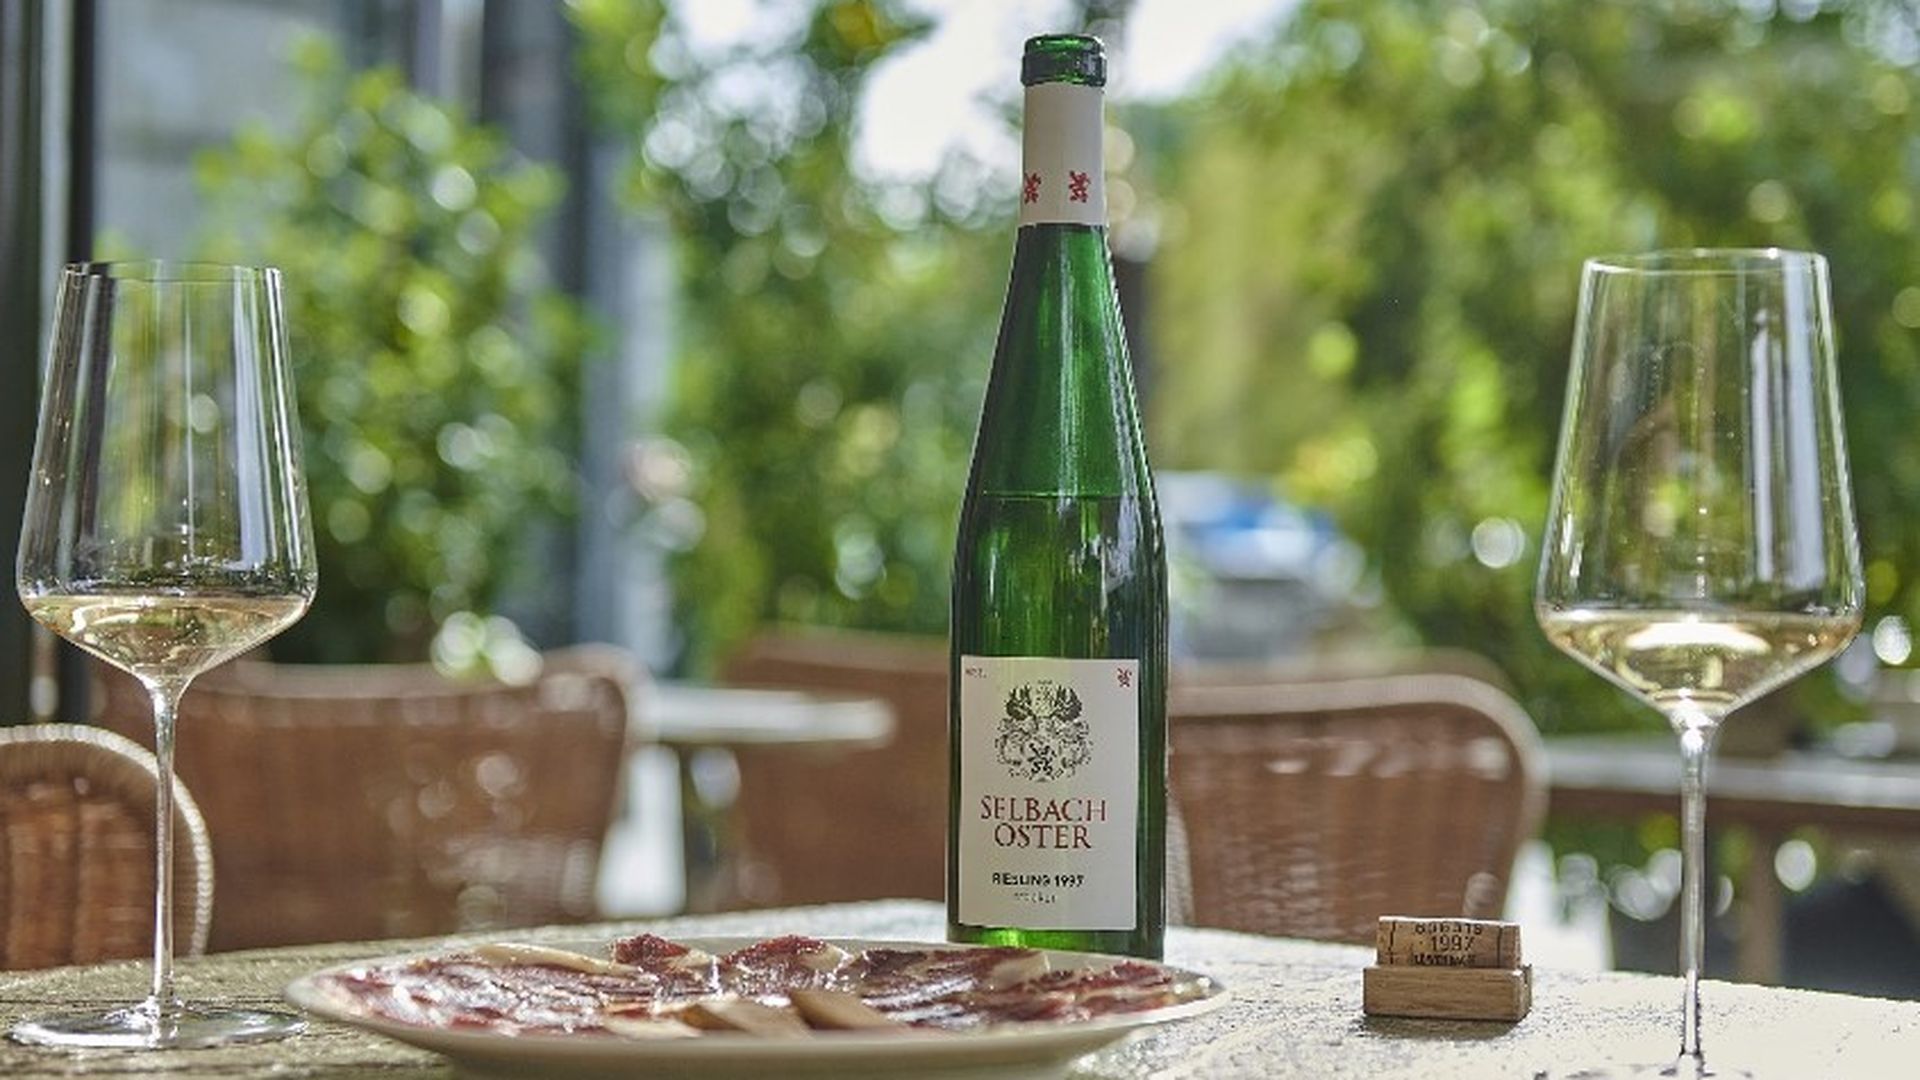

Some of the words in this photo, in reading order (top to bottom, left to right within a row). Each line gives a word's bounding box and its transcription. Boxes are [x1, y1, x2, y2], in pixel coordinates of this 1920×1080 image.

[980, 795, 1107, 822] SELBACH
[994, 823, 1092, 849] OSTER
[992, 872, 1050, 887] RIESLING
[1432, 934, 1475, 951] 1997
